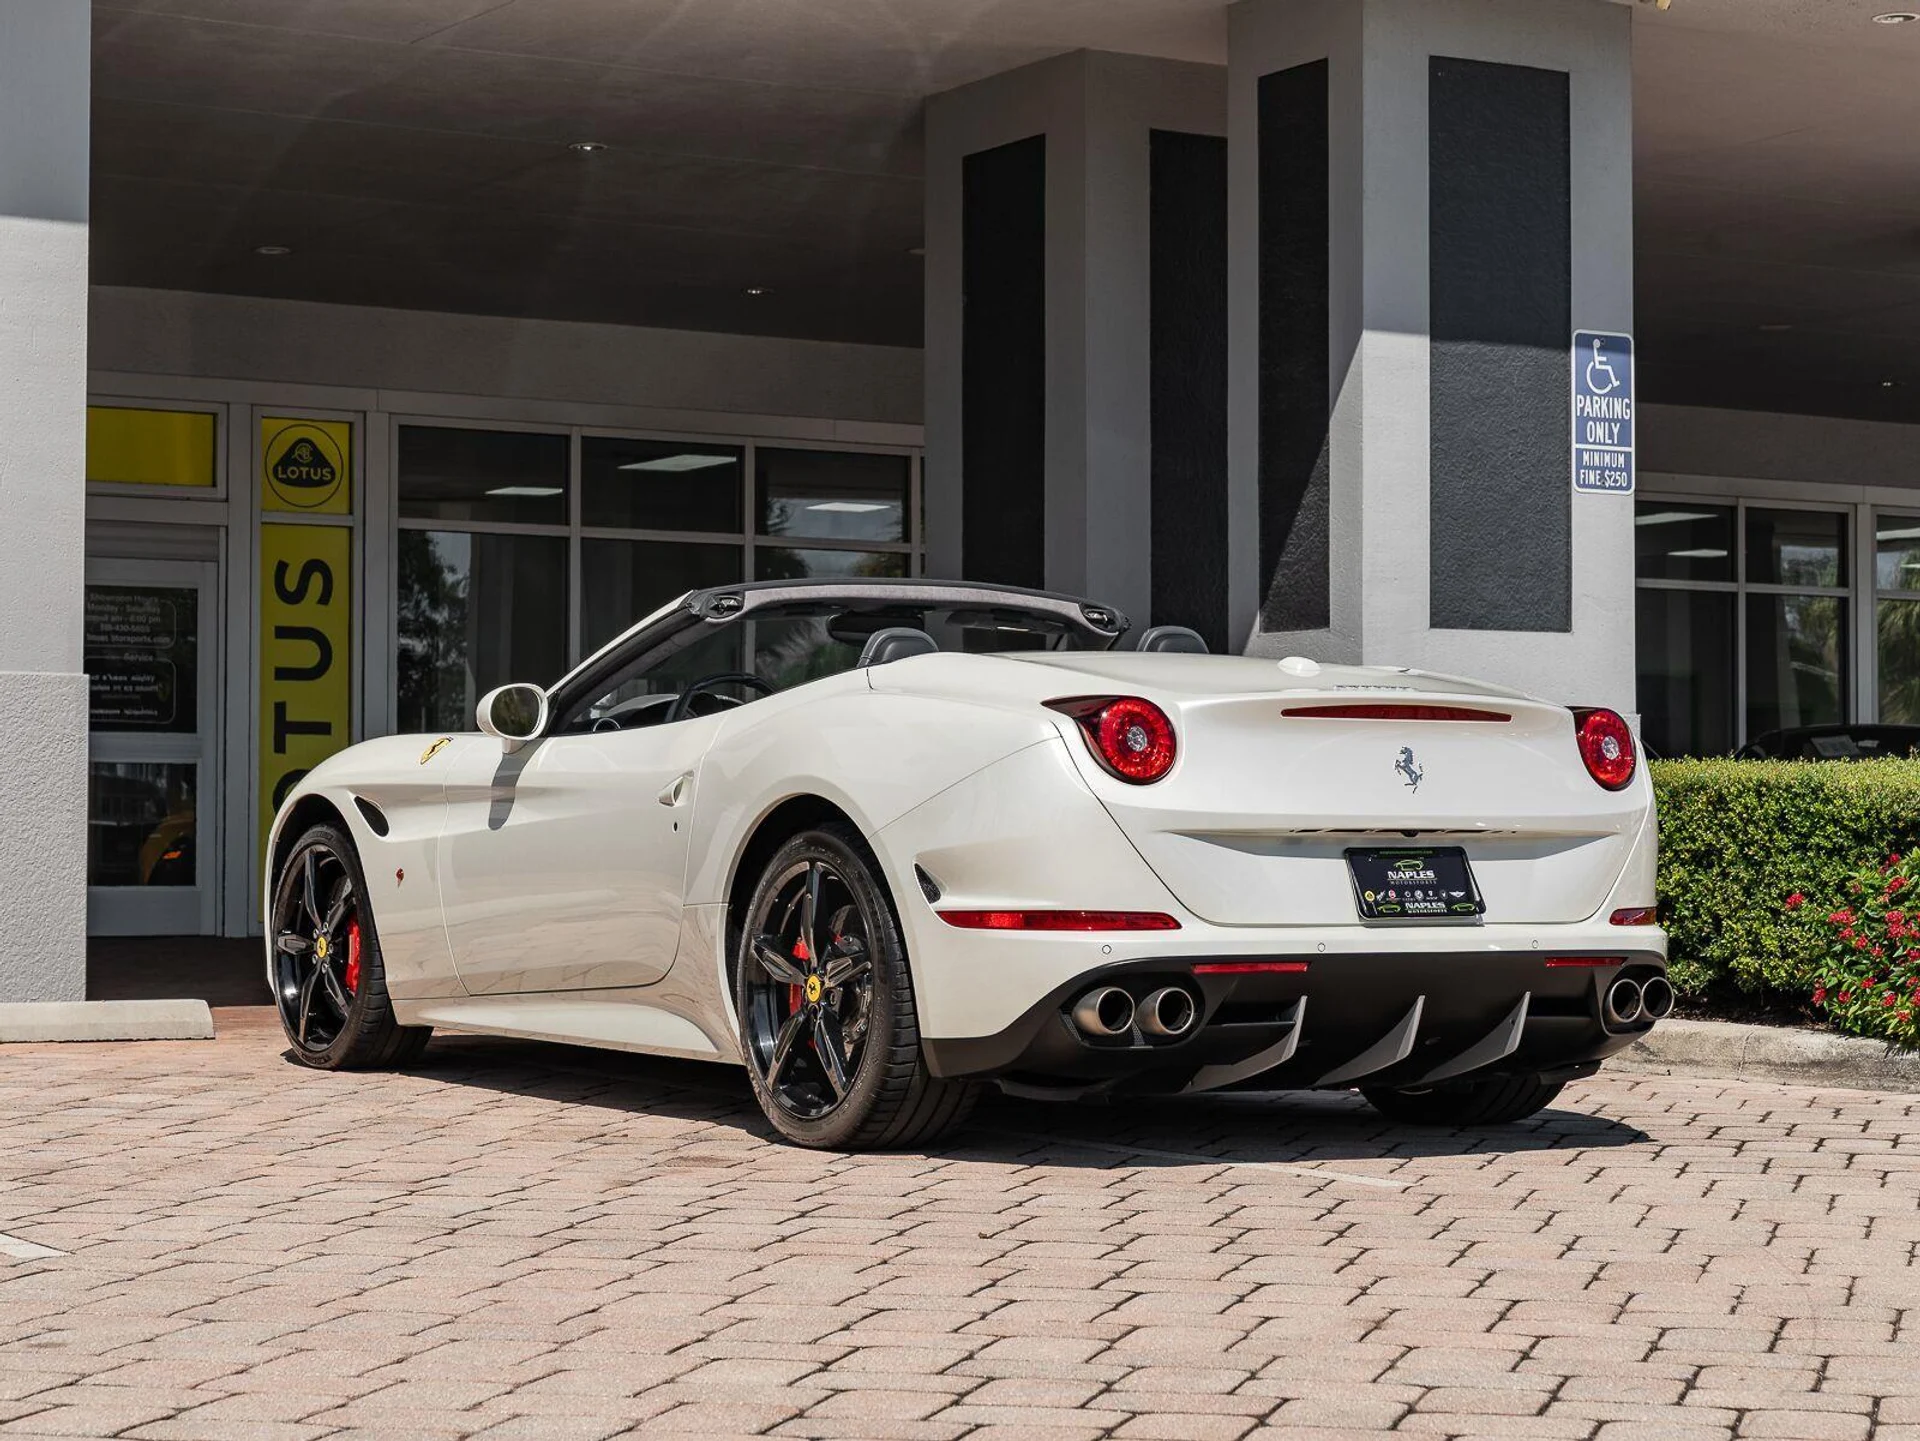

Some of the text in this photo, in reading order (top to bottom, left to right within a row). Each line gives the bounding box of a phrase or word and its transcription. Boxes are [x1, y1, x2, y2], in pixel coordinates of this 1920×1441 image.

[1576, 394, 1631, 420] PARKING
[1586, 422, 1621, 445] ONLY
[1582, 450, 1625, 468] MINIMUM
[277, 465, 332, 480] LOTUS
[1580, 469, 1628, 487] FINE $250
[1387, 870, 1436, 879] NAPLES
[1405, 901, 1446, 909] NAPLES
